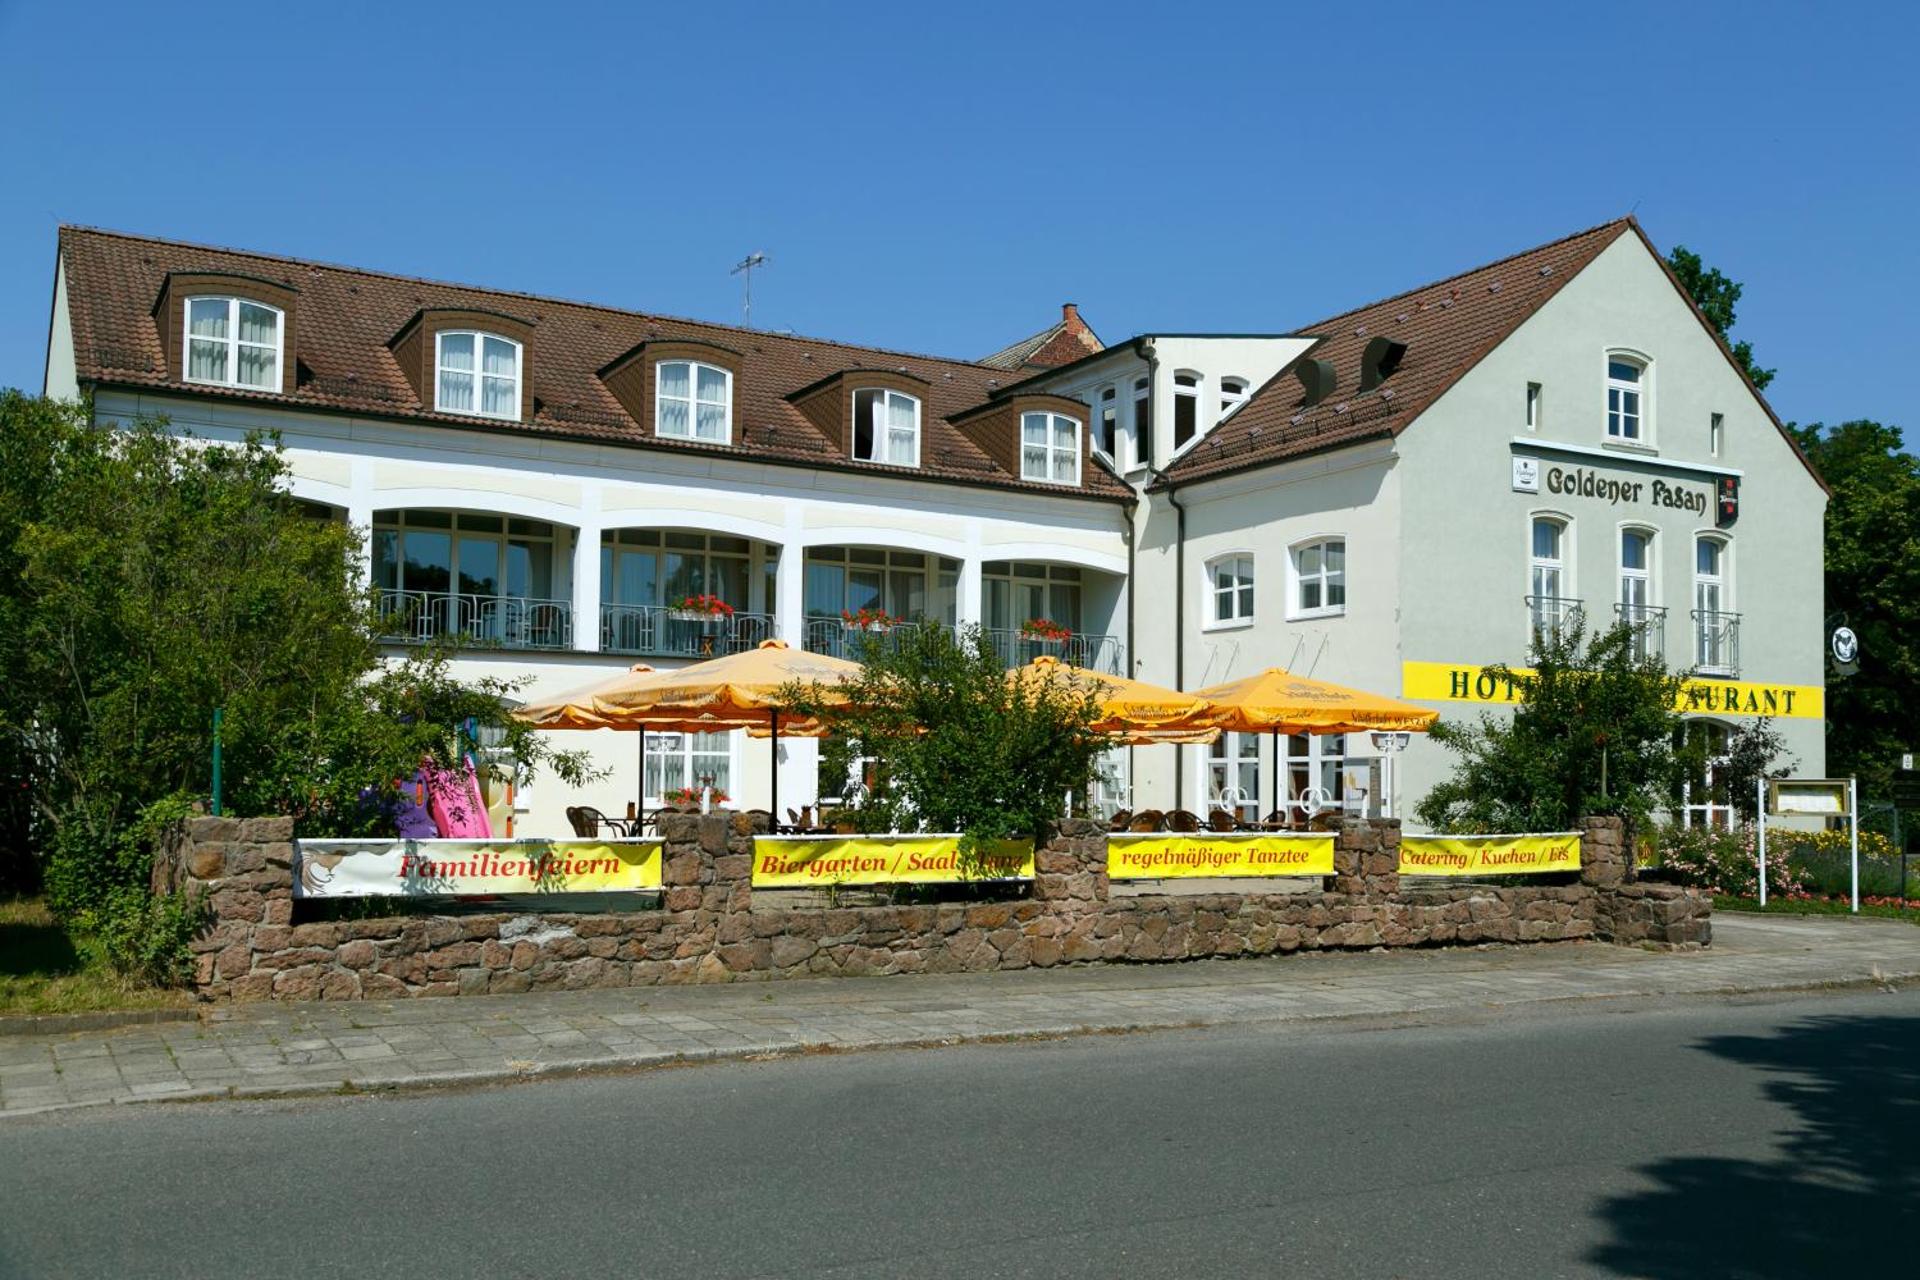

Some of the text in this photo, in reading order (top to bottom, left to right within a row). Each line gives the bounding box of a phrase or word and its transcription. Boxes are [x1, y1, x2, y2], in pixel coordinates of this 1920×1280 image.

[1547, 467, 1706, 517] Goldener Fasan
[397, 852, 620, 881] Familienfeiern
[760, 854, 886, 878] Biergarten
[907, 848, 957, 871] Saal
[1122, 848, 1309, 868] regelmäßiger Tanztee
[1400, 848, 1468, 869] Catering
[1481, 849, 1536, 865] Kuchen
